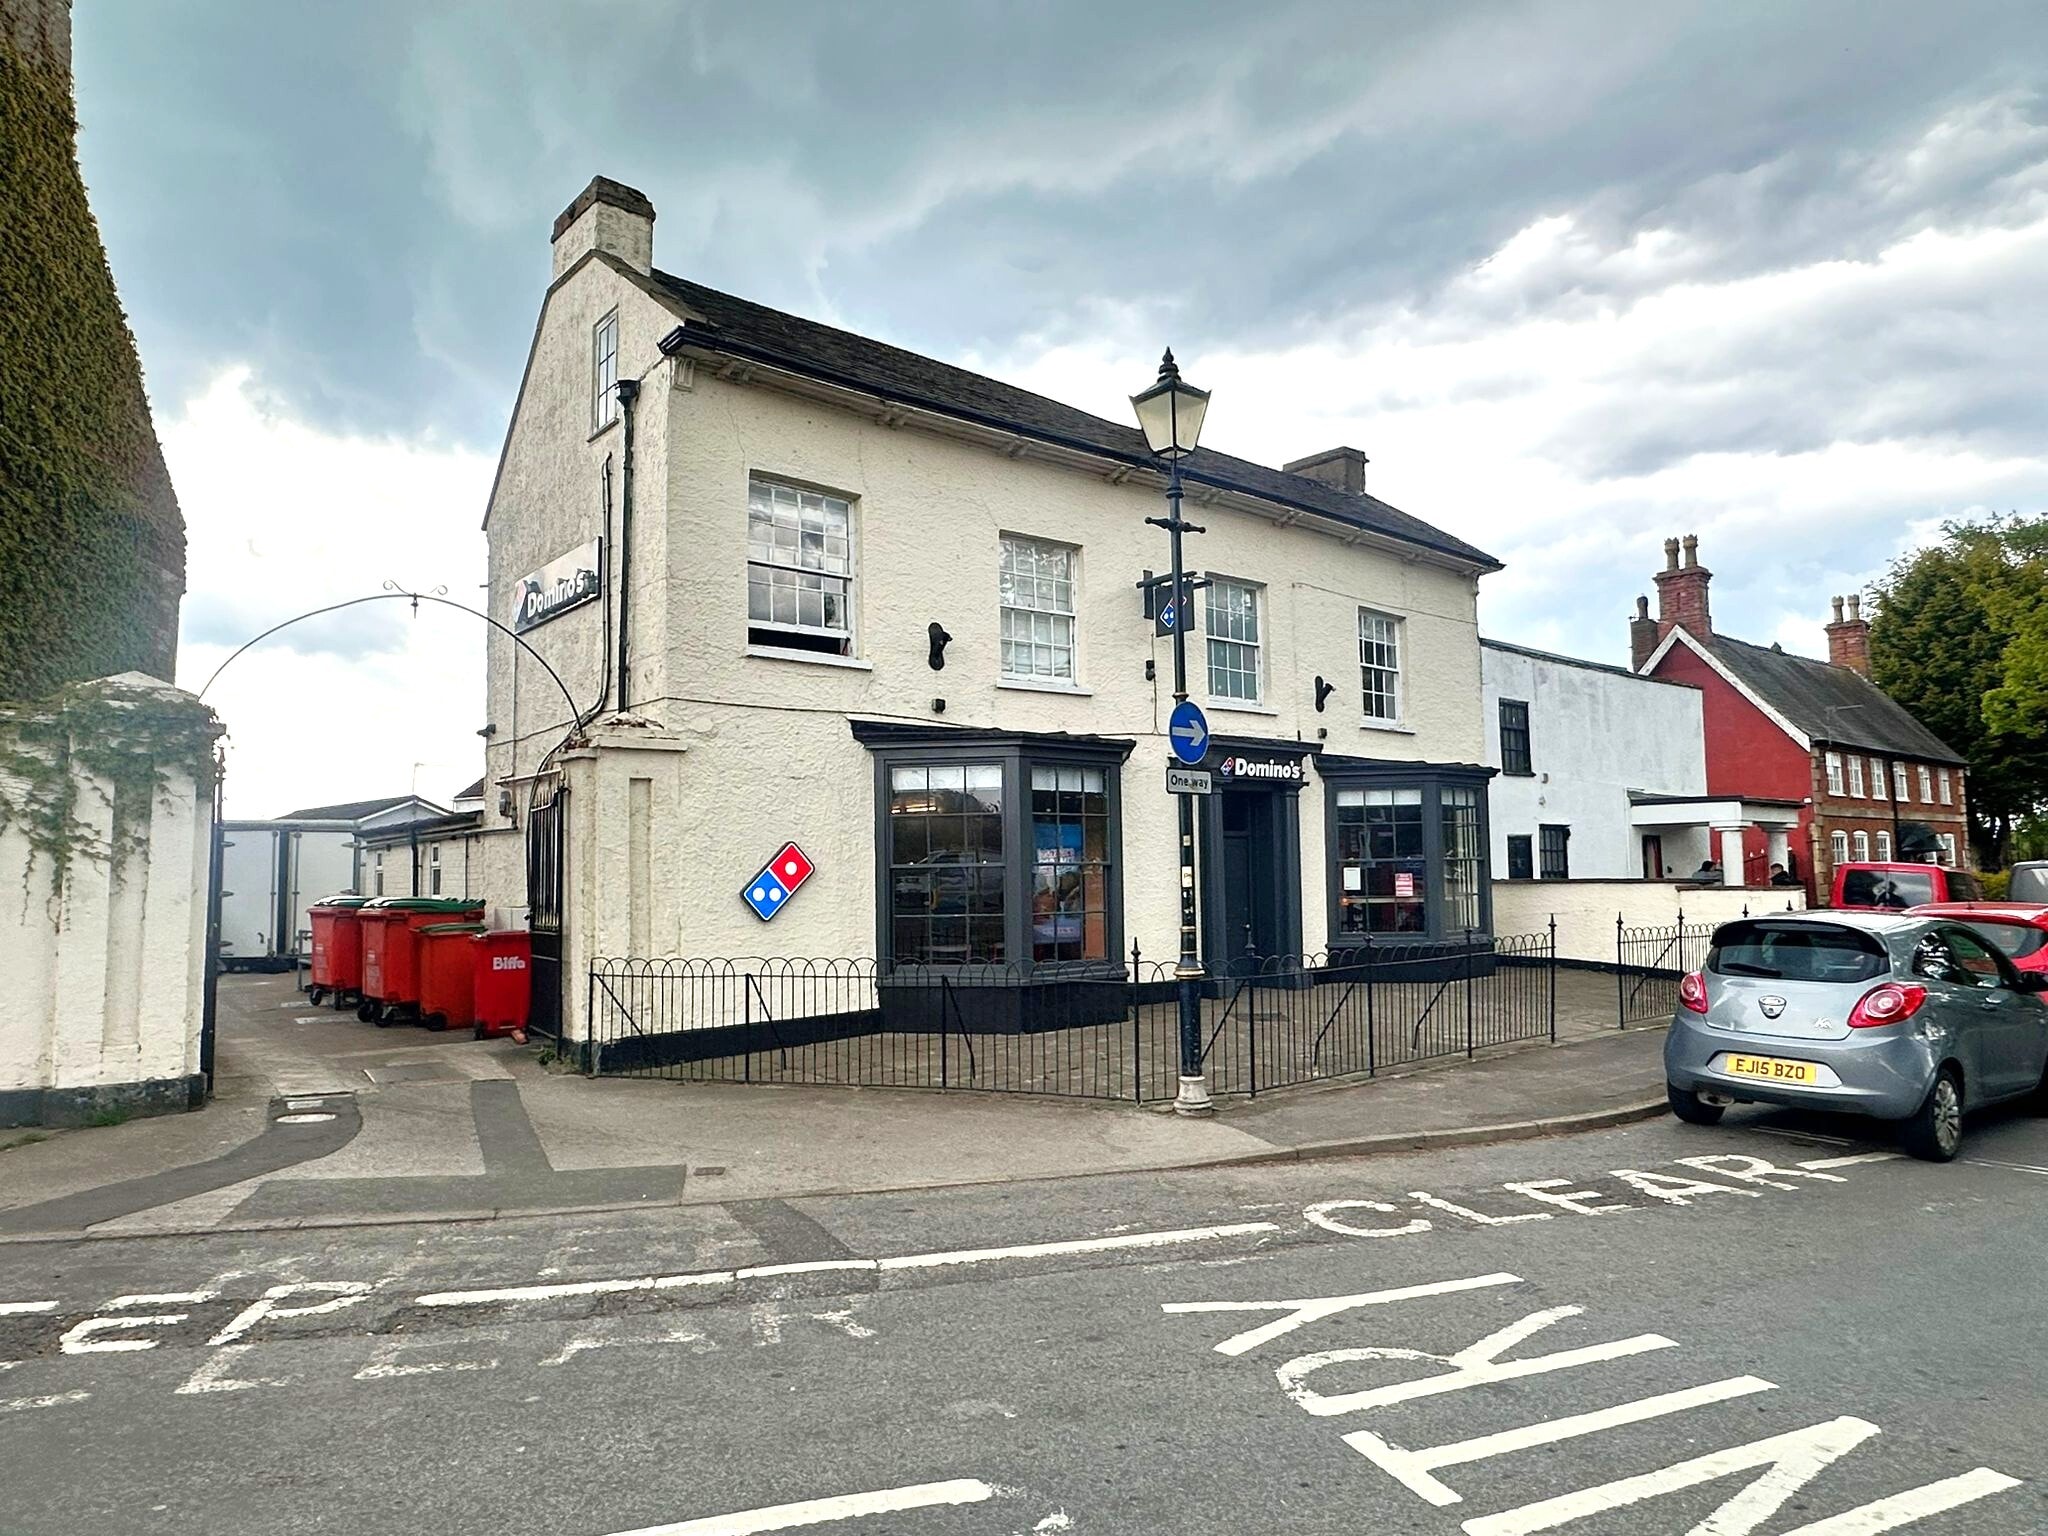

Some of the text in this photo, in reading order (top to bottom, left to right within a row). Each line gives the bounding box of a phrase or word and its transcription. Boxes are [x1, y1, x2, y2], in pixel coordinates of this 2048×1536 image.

[1235, 757, 1301, 779] Domino's
[1170, 774, 1209, 790] One way
[493, 956, 526, 970] Biffa
[1735, 1058, 1806, 1080] EJ15 BZO
[1303, 1153, 1848, 1239] CLEAR
